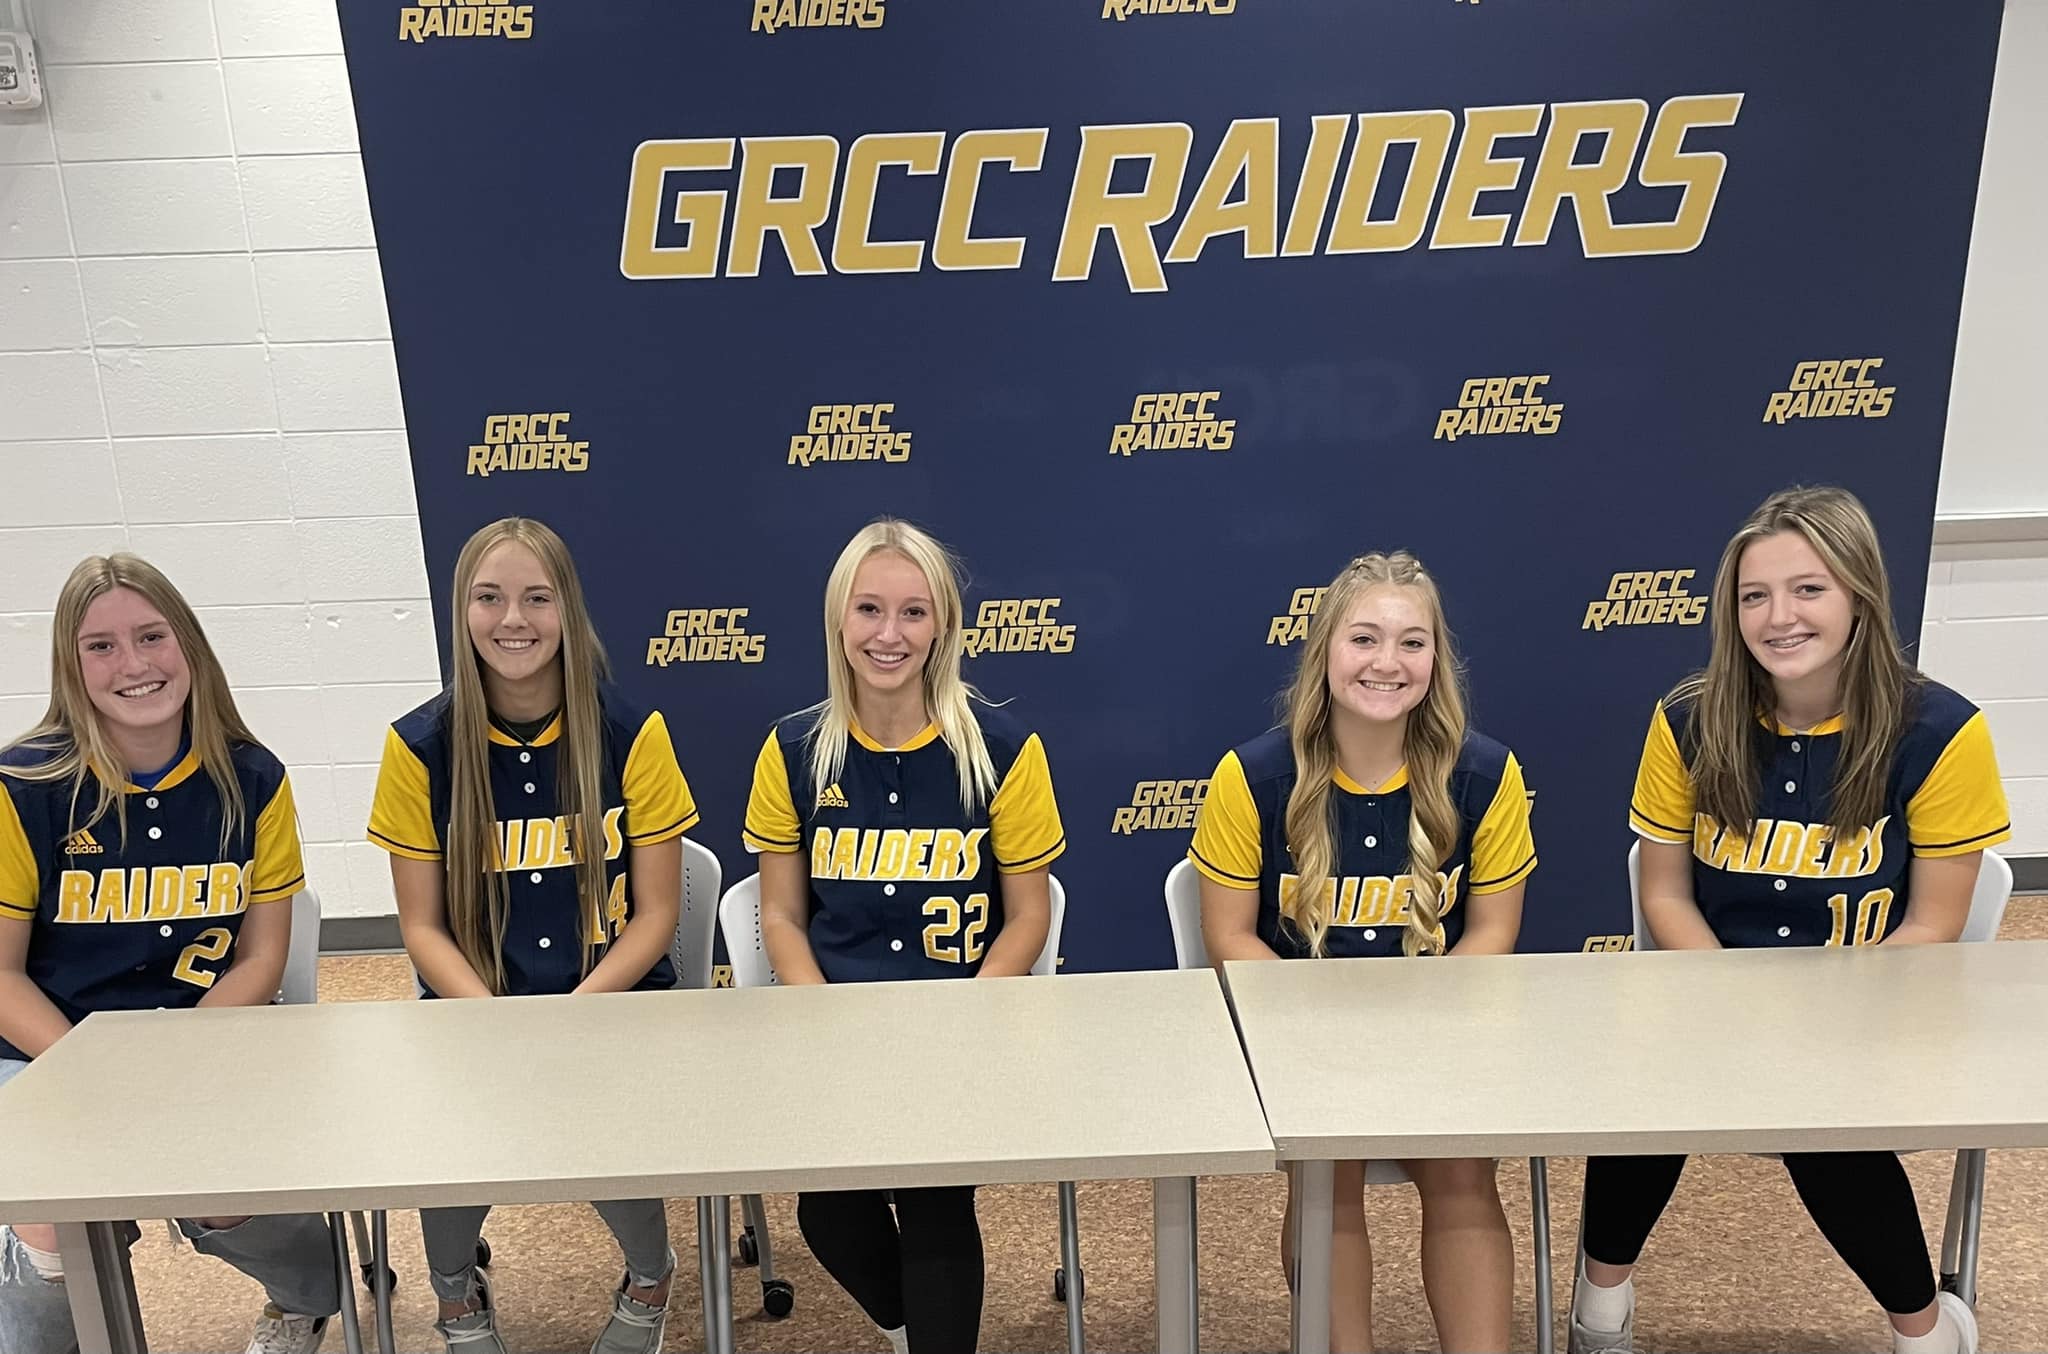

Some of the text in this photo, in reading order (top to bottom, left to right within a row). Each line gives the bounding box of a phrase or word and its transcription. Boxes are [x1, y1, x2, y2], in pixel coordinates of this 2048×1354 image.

[399, 6, 534, 43] RAIDERS
[751, 0, 886, 34] RAIDERS
[619, 93, 1745, 293] GRCC RAIDERS
[1789, 358, 1883, 391] GRCC
[1131, 392, 1220, 423] GRCC
[1458, 375, 1550, 408] GRCC
[1763, 387, 1896, 424] RAIDERS
[485, 413, 570, 444] GRCC
[808, 404, 894, 434] GRCC
[1434, 404, 1564, 441] RAIDERS
[788, 433, 912, 466] RAIDERS
[1109, 420, 1236, 456] RAIDERS
[467, 442, 589, 476] RAIDERS
[1606, 570, 1695, 600] GRCC
[665, 608, 748, 636] GRCC
[976, 599, 1061, 627] GRCC
[1582, 596, 1708, 631] RAIDERS
[647, 635, 765, 667] RAIDERS
[960, 625, 1077, 658] RAIDERS
[1111, 805, 1203, 835] RAIDE
[65, 844, 104, 855] adidas
[811, 827, 990, 881] RAIDERS
[922, 893, 990, 963] 22
[1825, 887, 1894, 947] 10
[172, 928, 240, 988] 2
